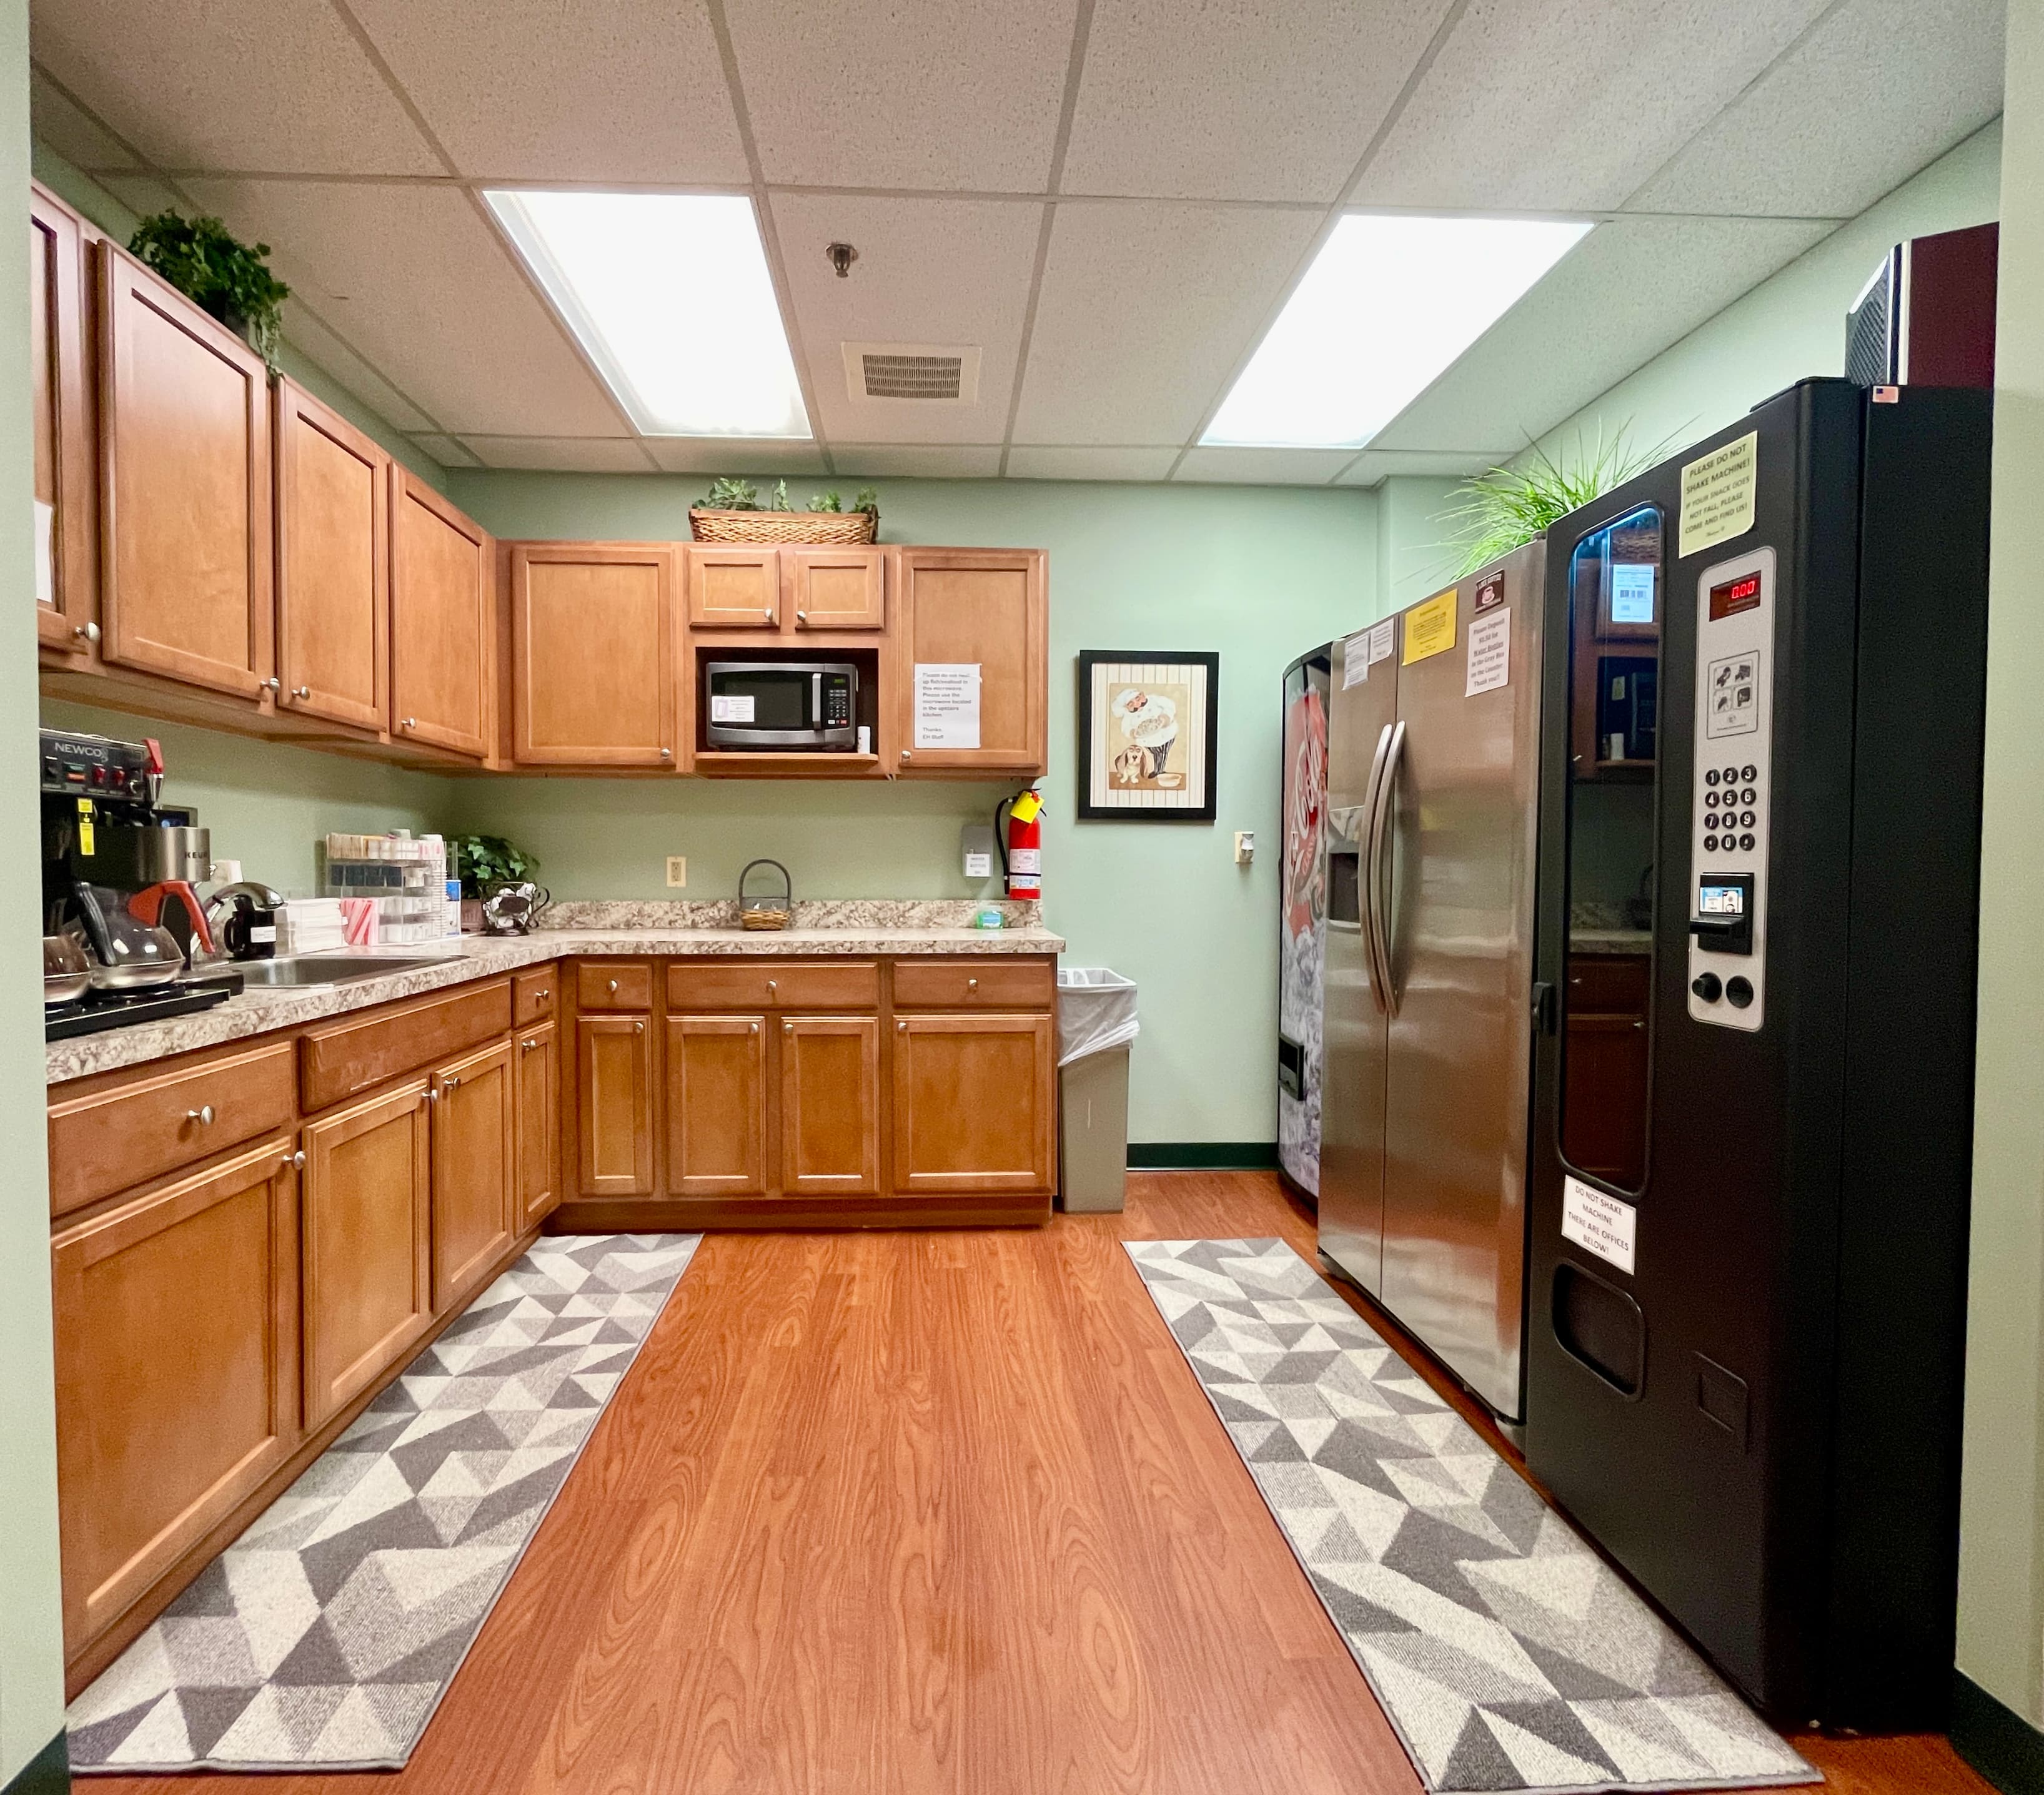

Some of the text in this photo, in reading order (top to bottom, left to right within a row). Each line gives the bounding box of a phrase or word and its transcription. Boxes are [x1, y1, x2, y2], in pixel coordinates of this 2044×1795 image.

[1689, 443, 1747, 478] PLEASE DO NOT
[1686, 457, 1750, 494] SHAKE MACHINE!
[1692, 495, 1709, 507] YOUR
[1710, 485, 1730, 498] SNACK
[1732, 476, 1750, 489] GOES
[1685, 522, 1703, 533] COME
[1705, 515, 1718, 525] AND
[1720, 508, 1735, 520] FIND
[1736, 502, 1747, 513] US!
[1690, 509, 1702, 519] NOT
[1720, 492, 1744, 507] PLEASE
[55, 742, 101, 758] NEWCO
[1710, 768, 1752, 783] 1 2 3
[1708, 791, 1751, 804] 4 5 6
[1709, 814, 1751, 827] 7 8 9
[1725, 838, 1731, 848] 0
[1575, 1185, 1622, 1216] DO NOT SHAKE
[1582, 1204, 1613, 1226] MACHINE
[1568, 1210, 1629, 1251] THERE ARE OFFICES
